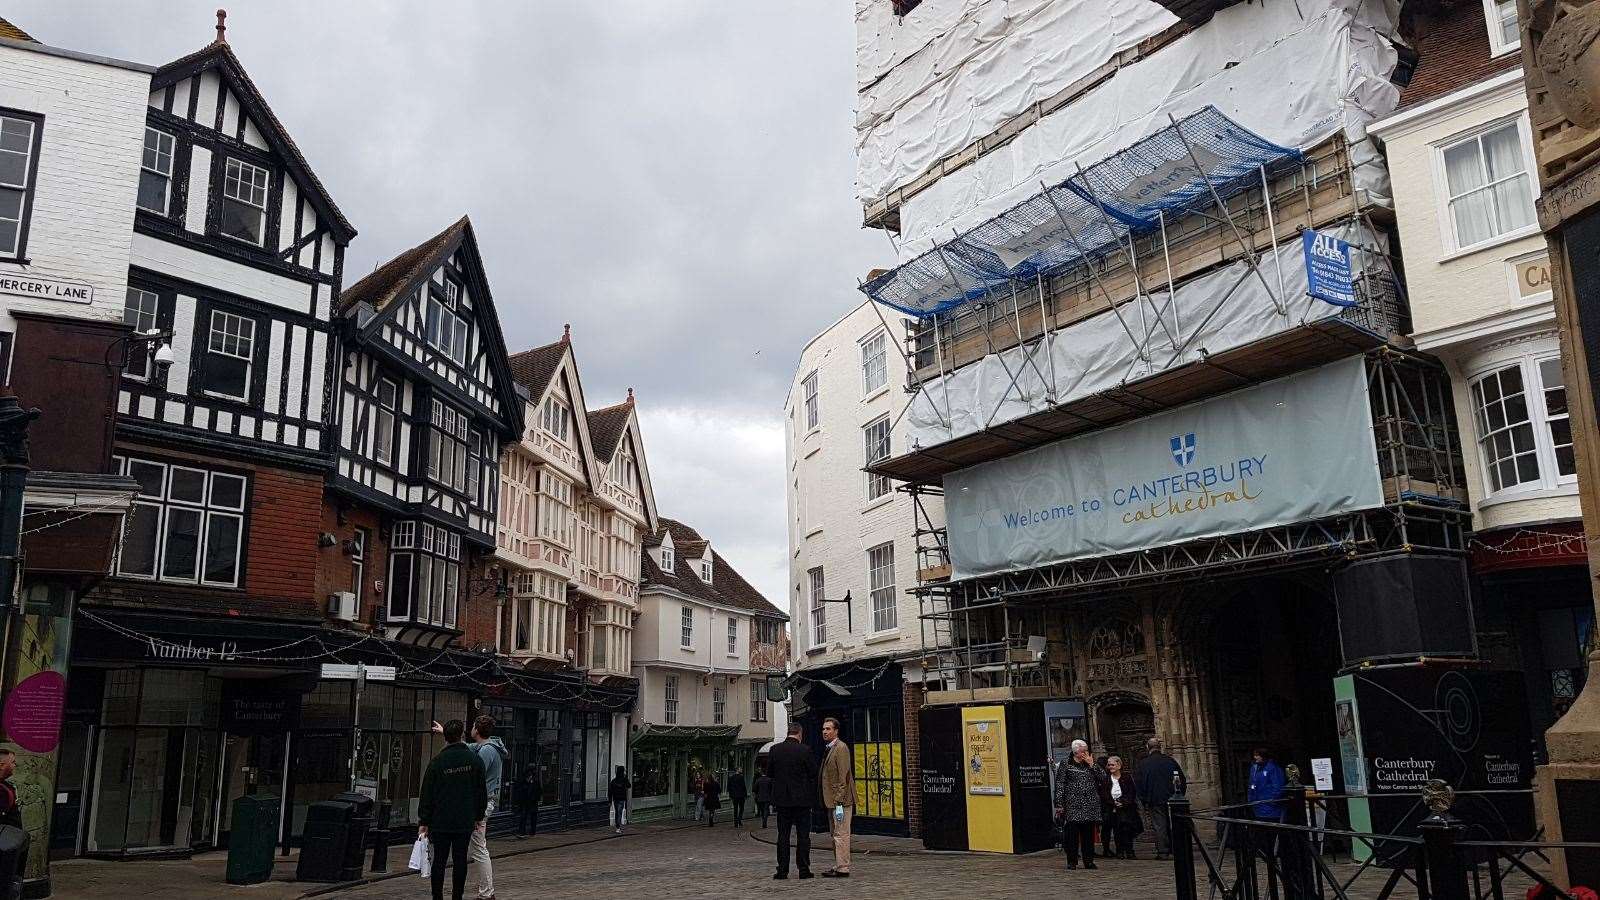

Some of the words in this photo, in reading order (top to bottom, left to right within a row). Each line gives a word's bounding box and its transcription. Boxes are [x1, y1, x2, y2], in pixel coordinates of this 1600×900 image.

[1313, 233, 1340, 252] ALL
[1311, 245, 1346, 264] ACCESS
[56, 285, 88, 299] LANE
[1004, 502, 1075, 529] Welcome
[1081, 499, 1101, 513] to
[1113, 454, 1268, 506] CANTERBURY
[1122, 479, 1263, 524] cathedral
[144, 637, 214, 660] Number
[220, 640, 237, 660] 12
[1375, 757, 1436, 771] Canterbury
[1486, 760, 1520, 774] Canterbury
[923, 774, 955, 786] Canterbury
[1376, 769, 1429, 781] Cathedral
[1488, 772, 1518, 784] Cathedral
[923, 784, 952, 793] Cathedral
